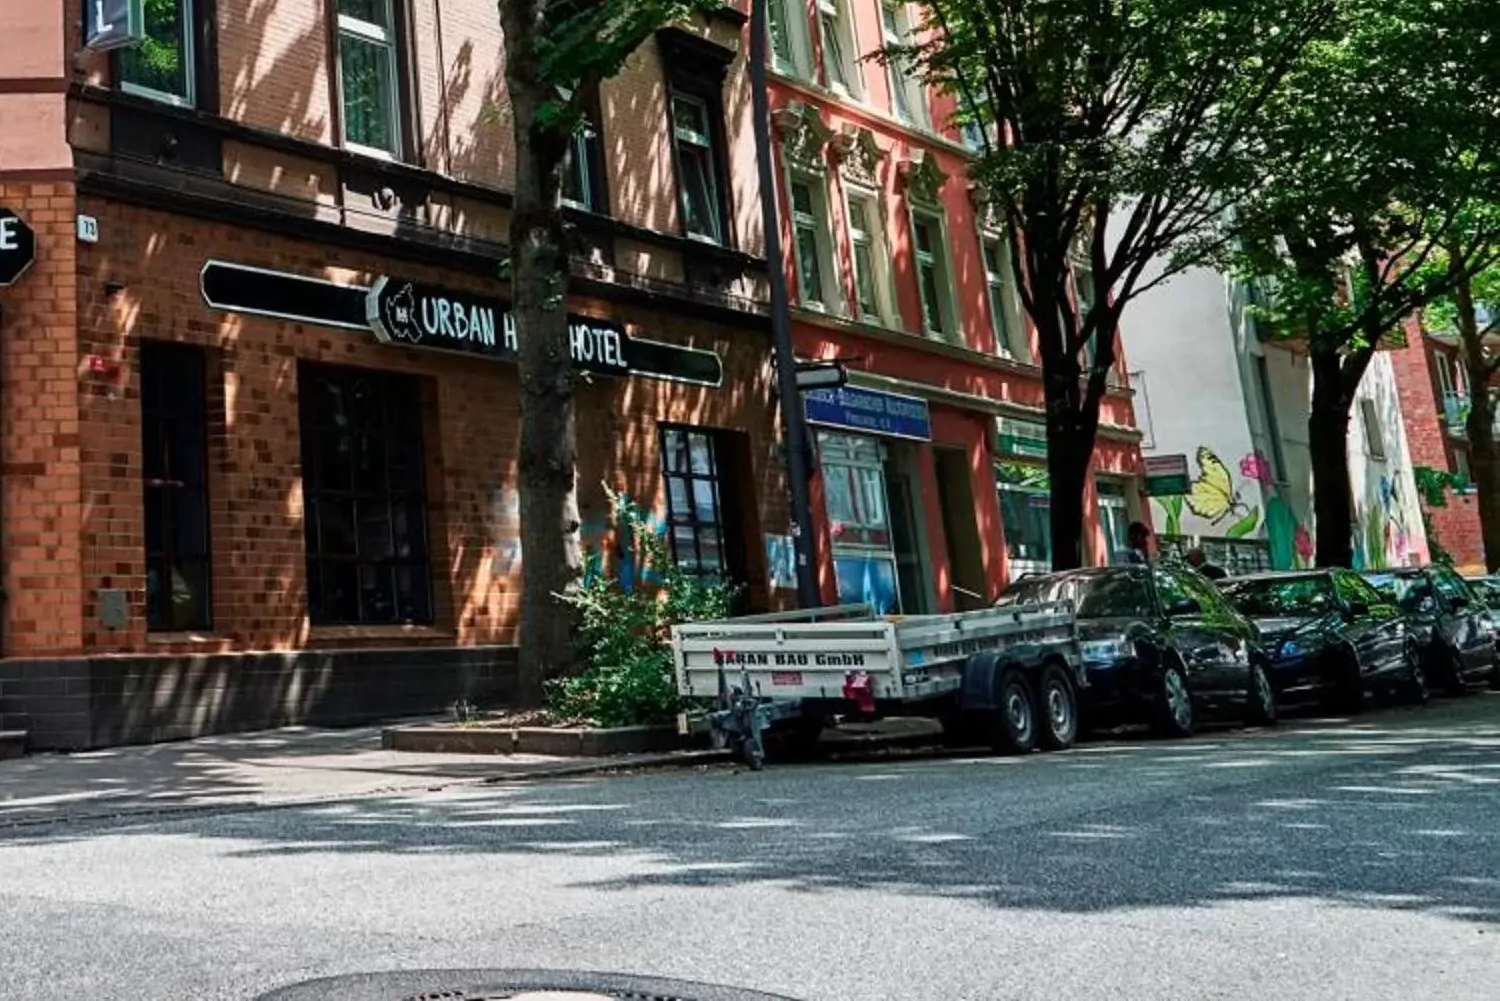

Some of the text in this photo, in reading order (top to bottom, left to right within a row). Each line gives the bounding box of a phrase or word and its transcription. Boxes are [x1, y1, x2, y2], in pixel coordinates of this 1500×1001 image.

[421, 296, 497, 347] URBAN
[568, 323, 628, 368] HOTEL
[815, 653, 865, 666] GmbH
